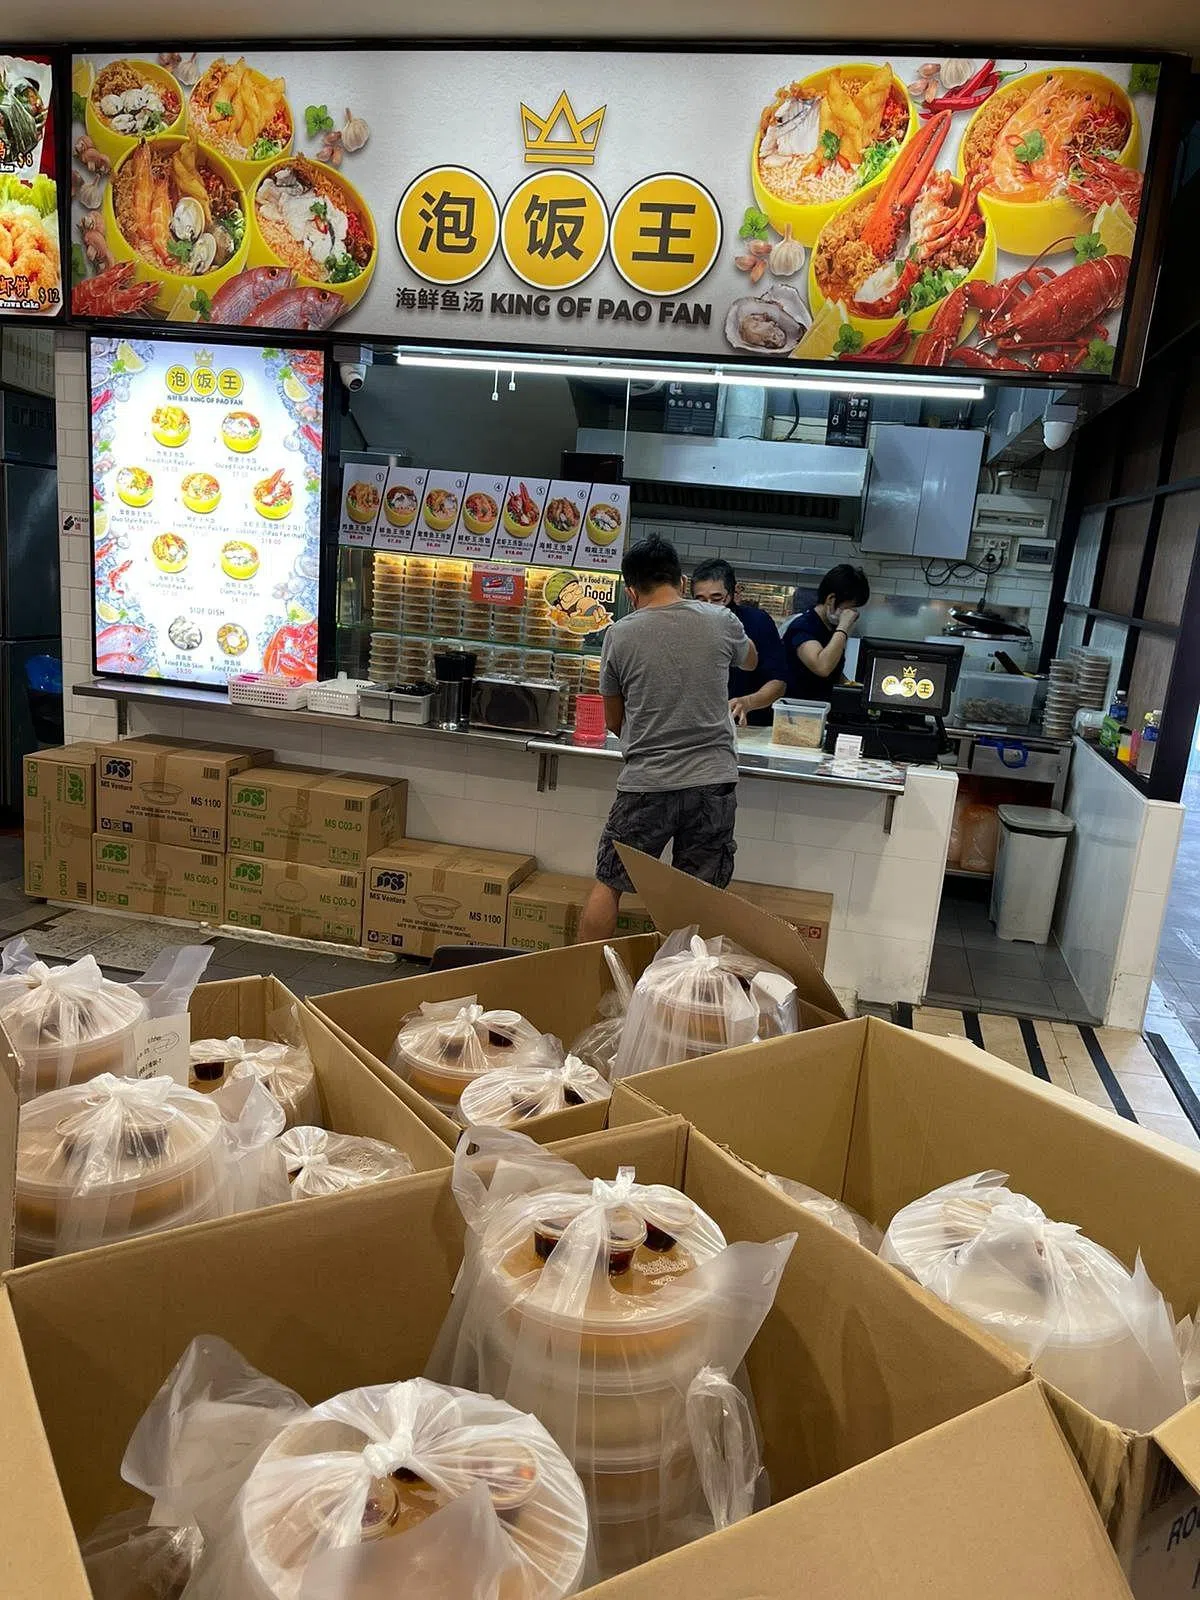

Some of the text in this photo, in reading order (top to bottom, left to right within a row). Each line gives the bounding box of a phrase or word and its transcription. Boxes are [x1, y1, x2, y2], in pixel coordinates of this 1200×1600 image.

[22, 300, 39, 309] Cake
[396, 287, 712, 326] 海鲜鱼汤 KING OF PAO FAN
[584, 585, 613, 601] Good
[207, 608, 225, 616] DISH
[191, 796, 221, 808] MS 1100
[324, 818, 336, 829] MS
[59, 860, 68, 871] MS
[183, 872, 194, 882] MS
[320, 894, 331, 904] MS
[469, 911, 502, 924] MS 1100
